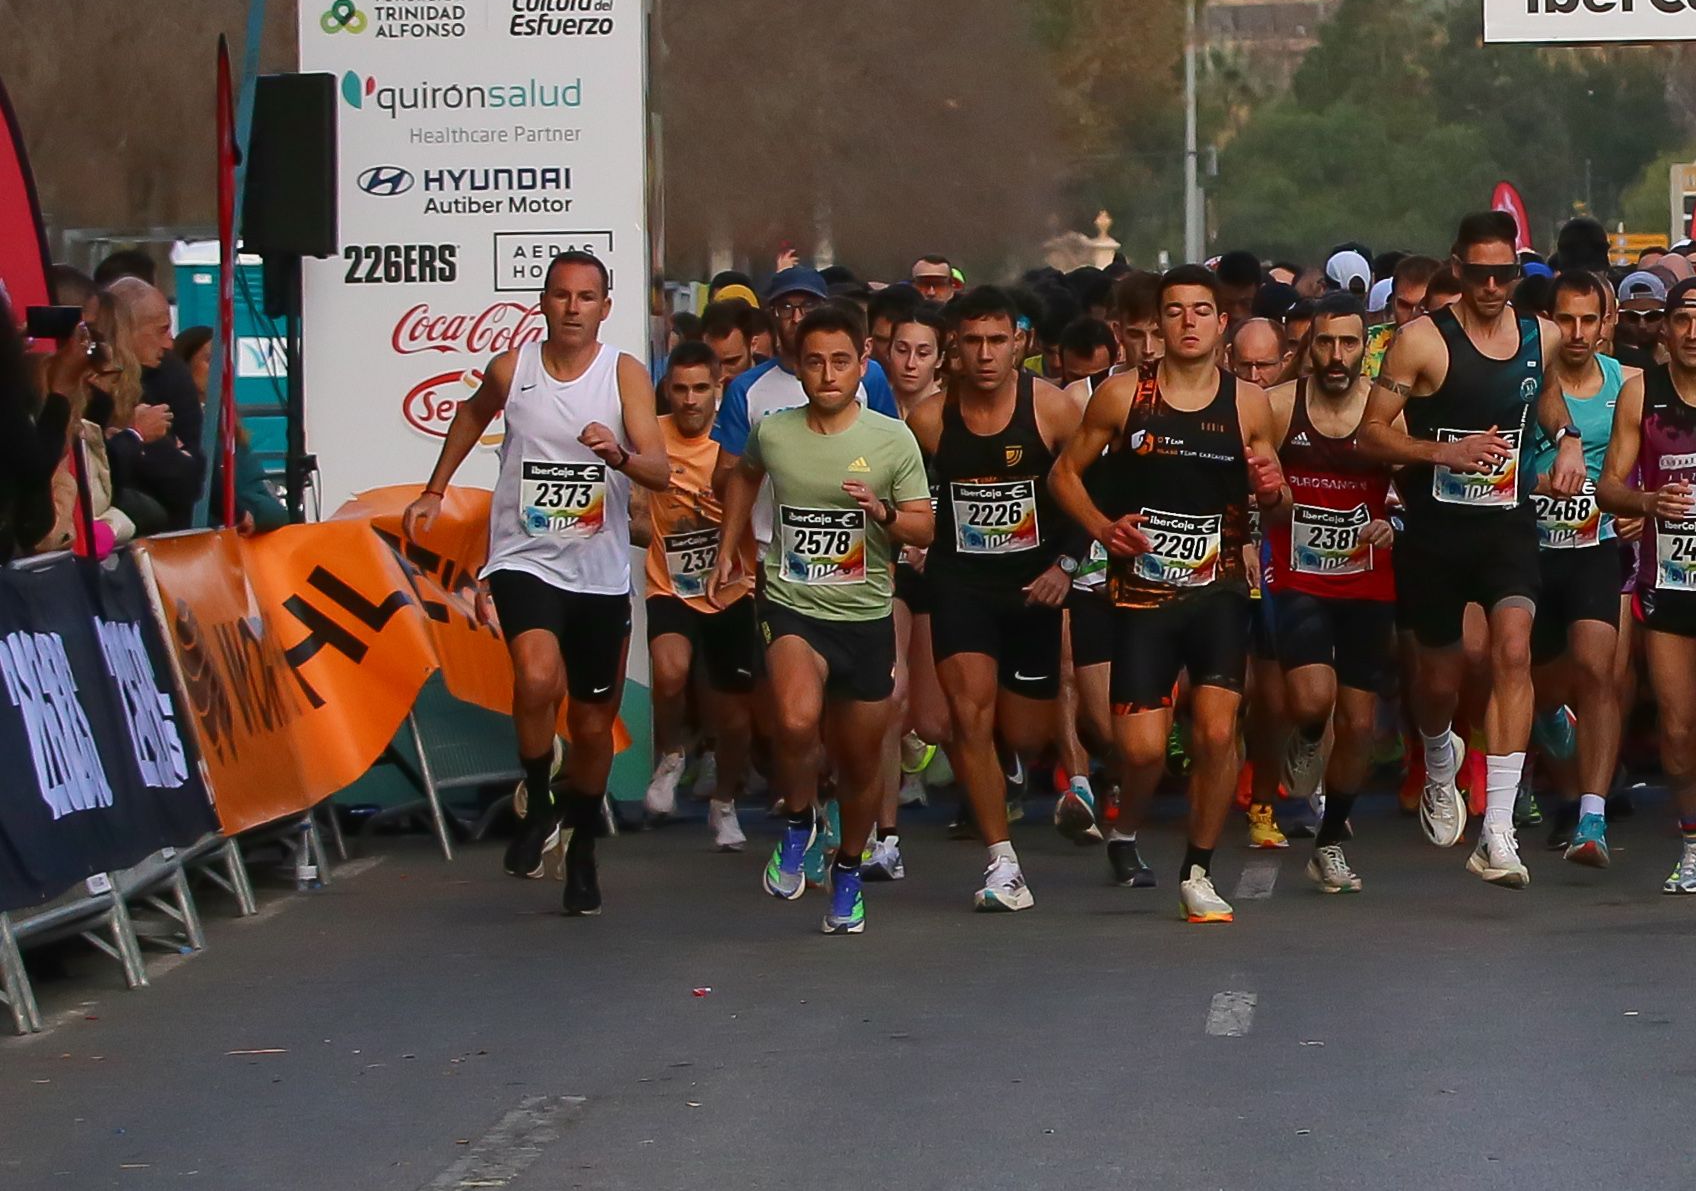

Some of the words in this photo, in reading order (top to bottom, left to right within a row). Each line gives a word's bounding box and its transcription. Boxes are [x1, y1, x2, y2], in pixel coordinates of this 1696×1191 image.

[375, 6, 466, 21] TRINIDAD
[594, 0, 613, 11] del
[375, 23, 466, 38] ALFONSO
[510, 15, 613, 36] Esfuerzo
[377, 78, 582, 119] quirónsalud
[410, 127, 508, 144] Healthcare
[514, 126, 582, 143] Partner
[424, 167, 572, 192] HYUNDAI
[424, 197, 503, 214] Autiber
[508, 196, 573, 214] Motor
[344, 244, 458, 284] 226ERS
[513, 244, 595, 259] AEDAS
[392, 302, 547, 355] Coca-Cola
[534, 482, 593, 508] 2373
[968, 501, 1022, 526] 2226
[1536, 497, 1591, 522] 2468
[1150, 515, 1195, 531] iberCaja
[793, 529, 851, 555] 2578
[1152, 533, 1208, 560] 2290
[681, 547, 718, 574] 232
